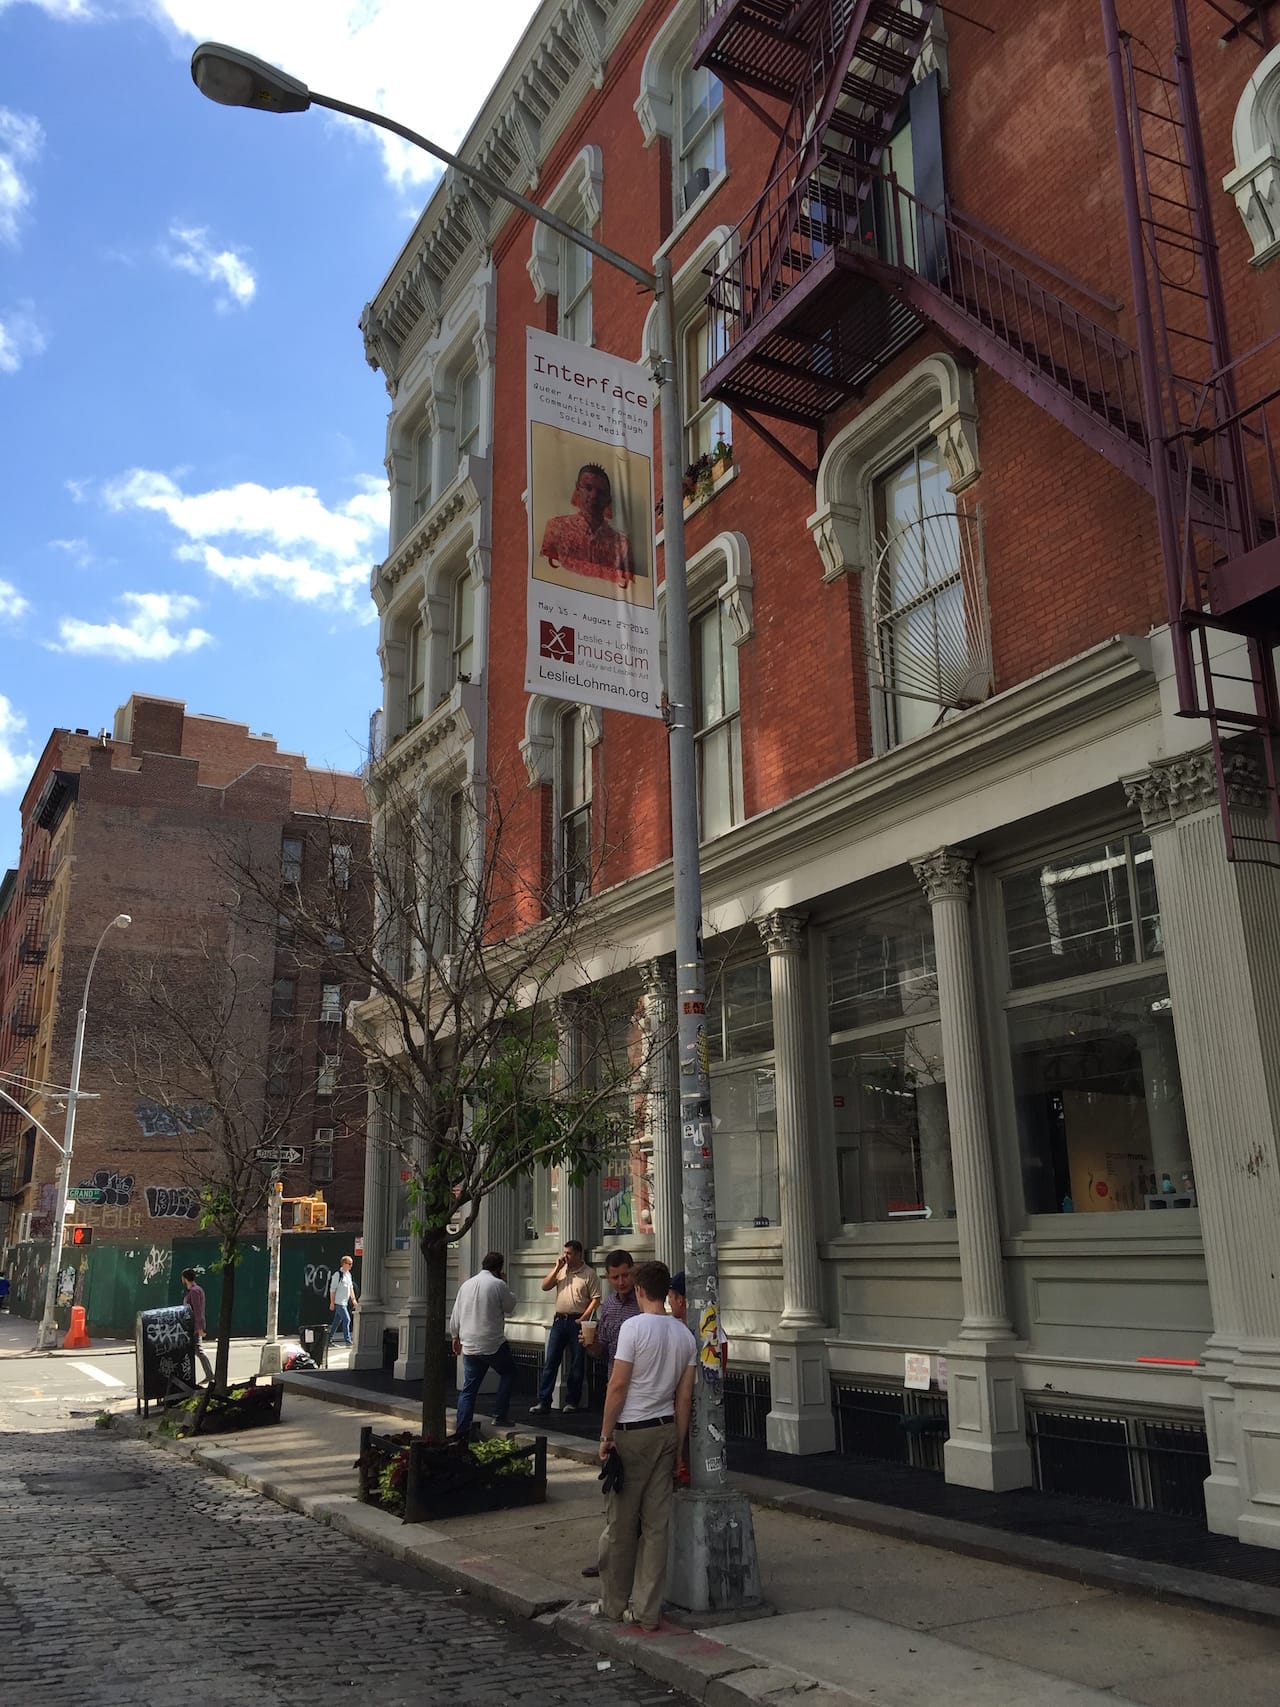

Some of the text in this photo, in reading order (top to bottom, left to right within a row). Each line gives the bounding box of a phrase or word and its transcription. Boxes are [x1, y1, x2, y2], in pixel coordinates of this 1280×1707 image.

[534, 354, 648, 408] Interface
[533, 382, 648, 428] Queer Artists Forming
[539, 395, 643, 435] Communities Through
[559, 411, 626, 438] Social Media
[538, 601, 554, 614] May
[558, 607, 569, 616] 15
[582, 613, 612, 626] August
[630, 623, 649, 635] 2015
[577, 632, 603, 646] Leslie
[615, 639, 649, 655] Lohman
[577, 644, 648, 670] museum
[539, 666, 649, 703] LeslieLohman.org
[69, 1190, 93, 1198] GRAND
